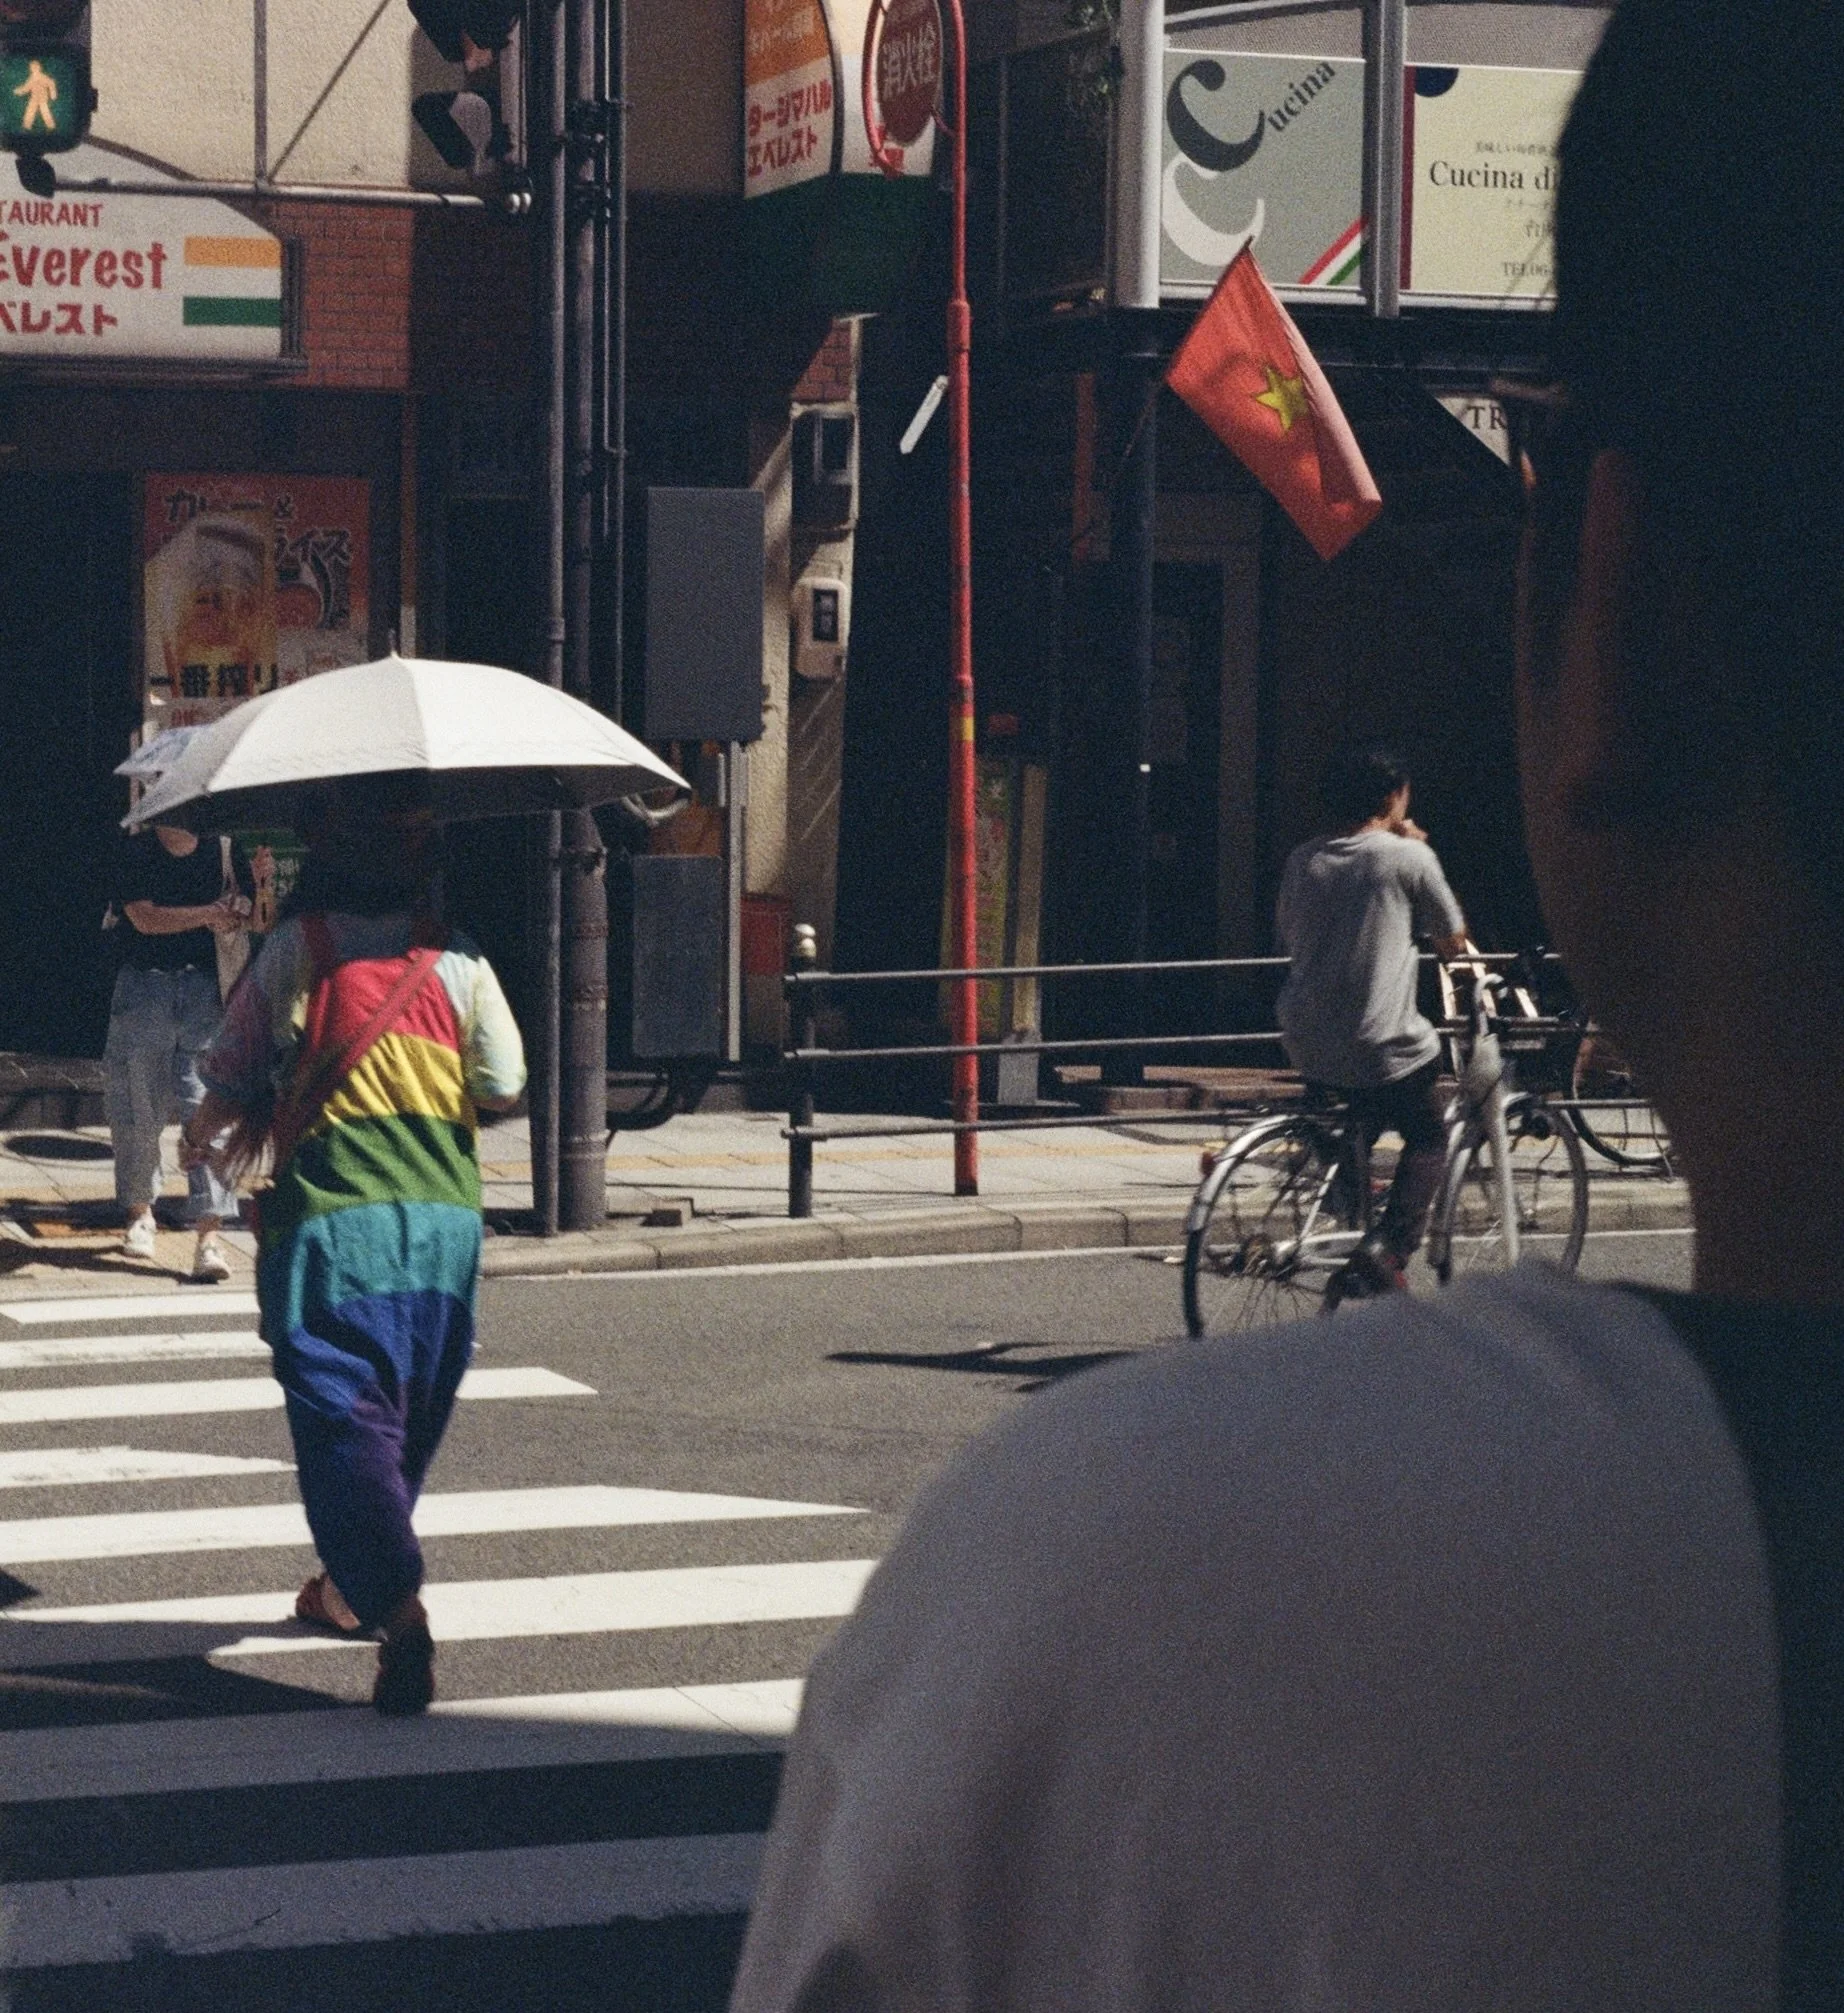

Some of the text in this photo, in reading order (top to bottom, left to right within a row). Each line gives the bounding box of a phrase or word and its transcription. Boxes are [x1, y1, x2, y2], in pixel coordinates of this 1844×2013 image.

[883, 21, 936, 100] 消火栓
[749, 79, 832, 137] タージマハル
[1429, 160, 1524, 189] Cucina
